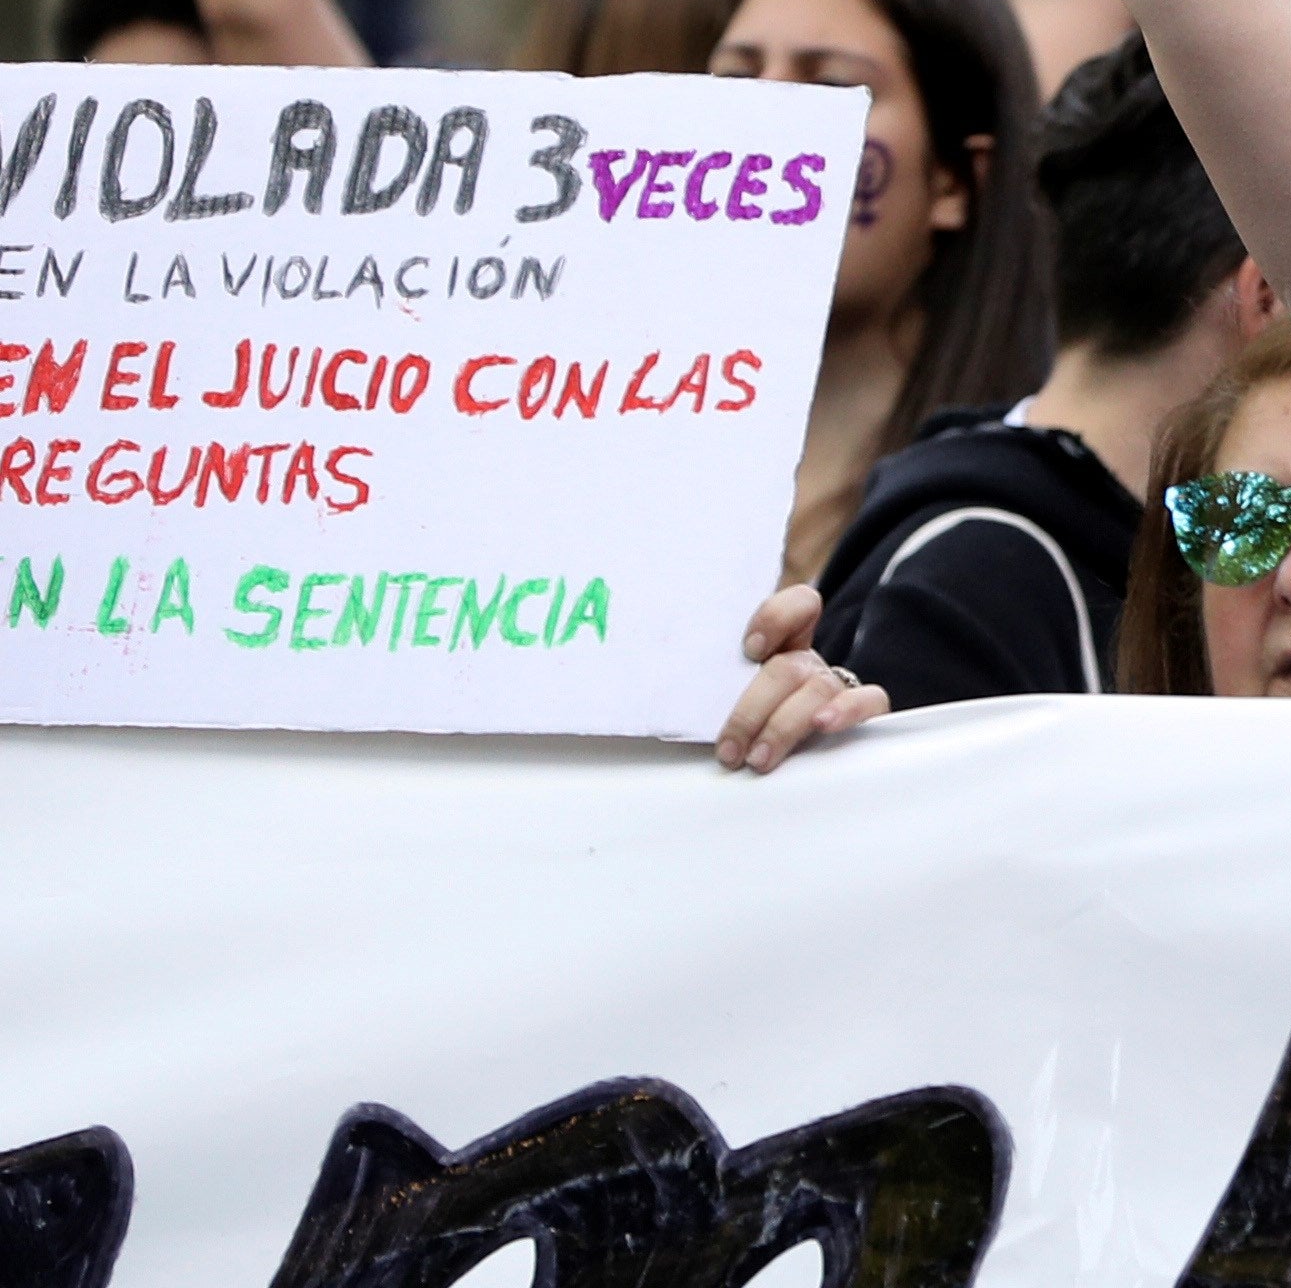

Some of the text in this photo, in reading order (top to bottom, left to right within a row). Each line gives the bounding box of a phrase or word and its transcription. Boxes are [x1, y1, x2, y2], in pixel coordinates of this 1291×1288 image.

[0, 92, 825, 226] VIOLADA 3 VECES
[0, 237, 566, 309] EN LA VIOLACIÓN
[0, 338, 763, 420] EN EL JUICIO CON LAS
[0, 554, 611, 653] N LA SENTENCIA
